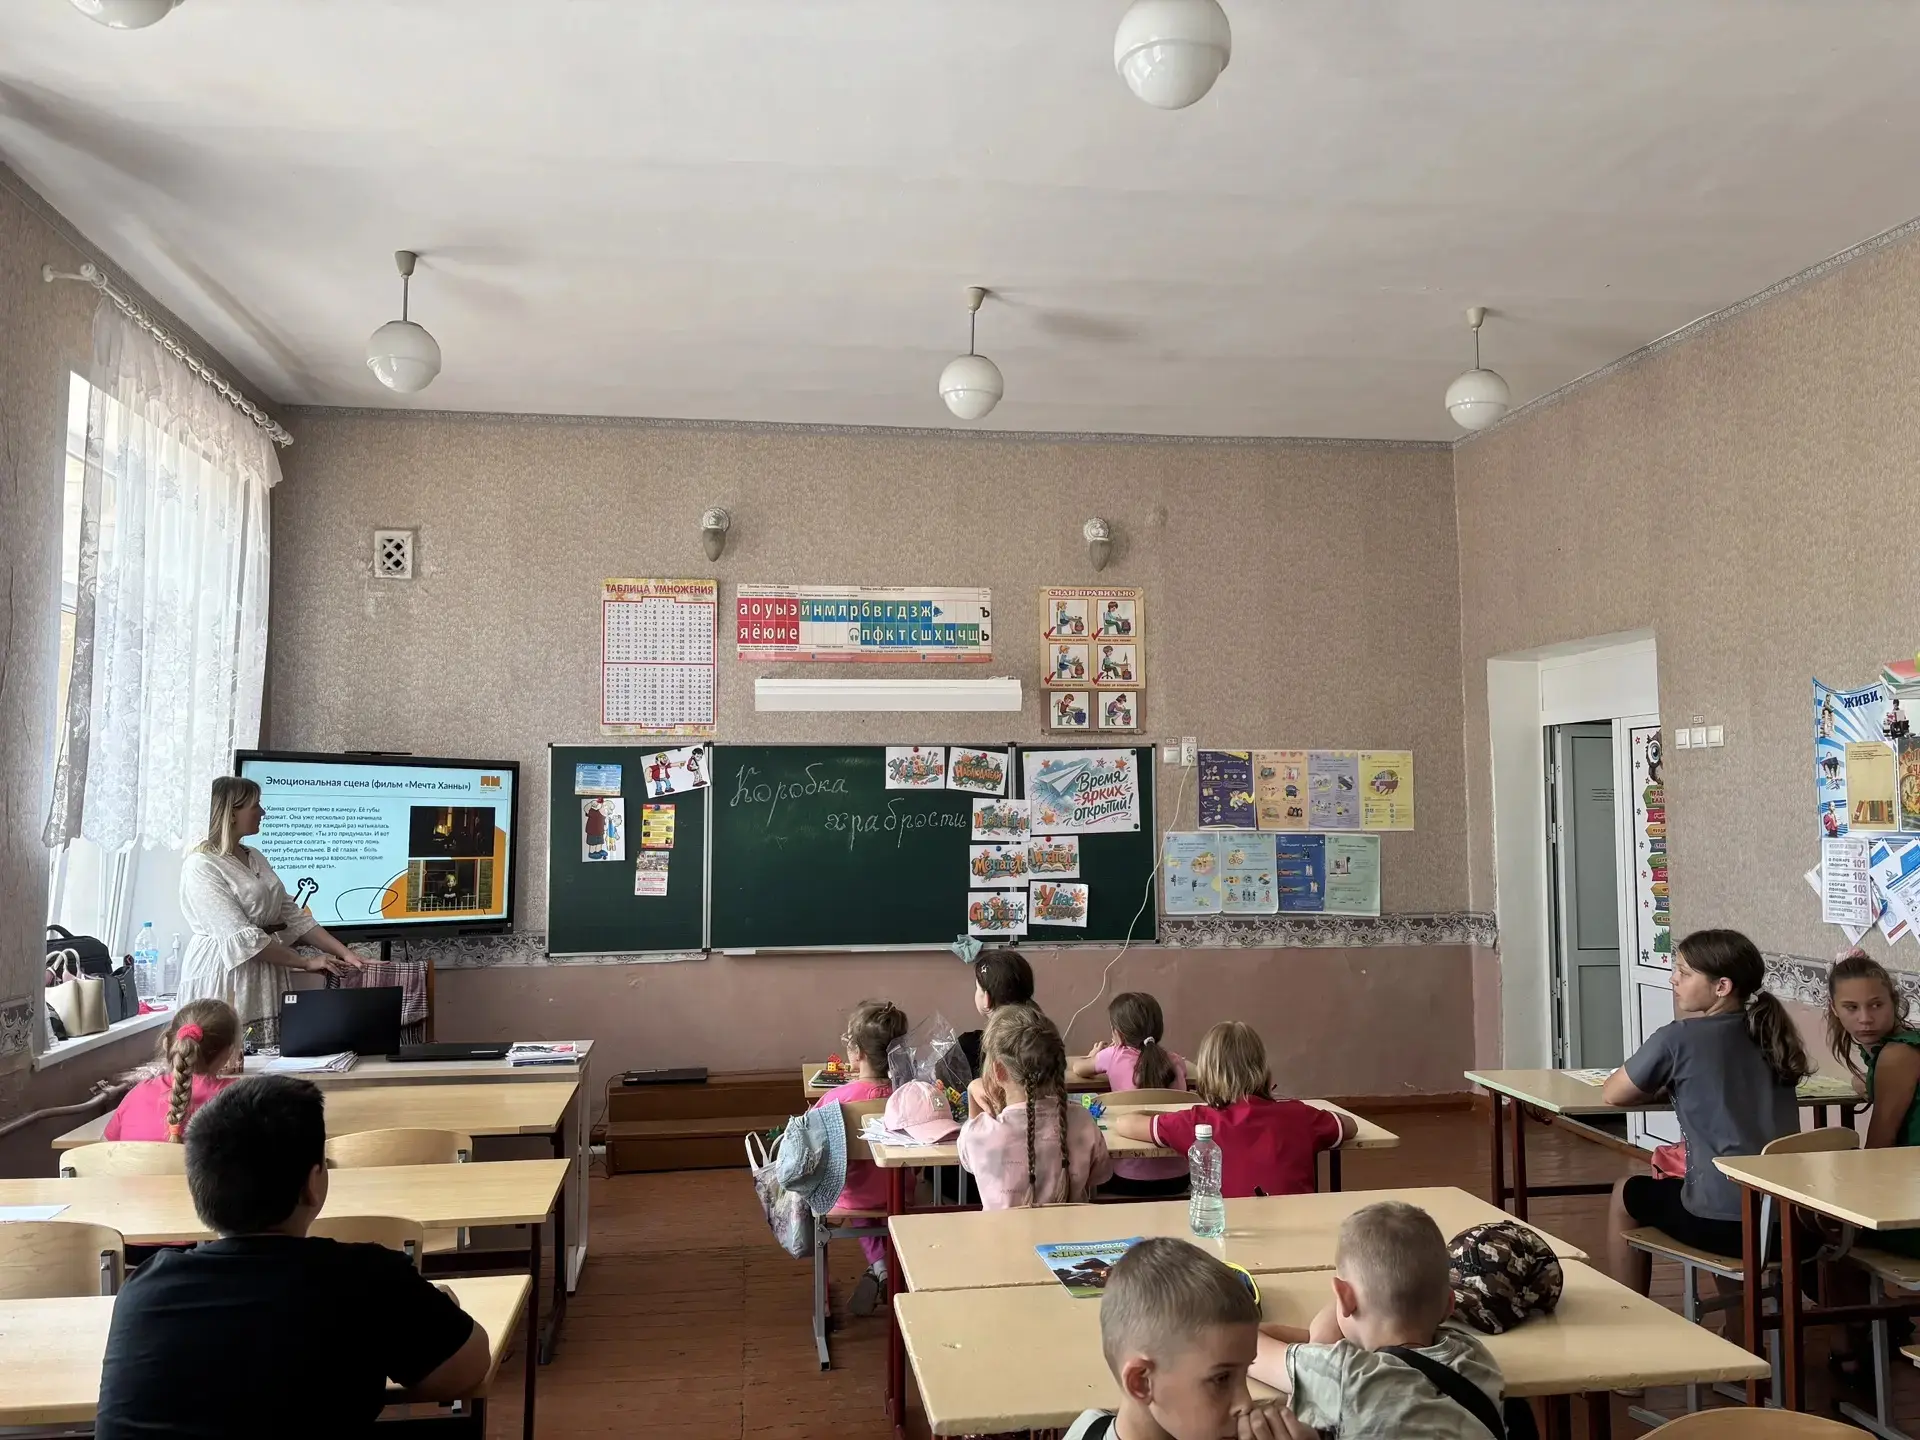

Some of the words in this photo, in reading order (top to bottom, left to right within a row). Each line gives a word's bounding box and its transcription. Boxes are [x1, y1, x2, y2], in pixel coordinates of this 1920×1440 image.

[606, 584, 650, 594] ТАБЛИЦА
[653, 585, 713, 594] УМНОЖЕНИЯ
[1080, 589, 1135, 597] ПРАВИЛЬНО
[1844, 690, 1882, 710] ЖИВИ,
[265, 776, 341, 787] Эмоциональная
[372, 780, 403, 789] (фильм
[405, 781, 436, 790] «Мечта
[438, 782, 471, 791] Ханны»)
[1076, 771, 1128, 792] Время
[729, 762, 849, 827] Коробка
[1081, 785, 1125, 806] ярких
[1074, 793, 1134, 821] открытий!
[824, 797, 968, 850] храбрости
[1853, 859, 1866, 868] 101
[1853, 872, 1866, 880] 102
[1853, 884, 1867, 893] 103
[1853, 897, 1867, 906] 104
